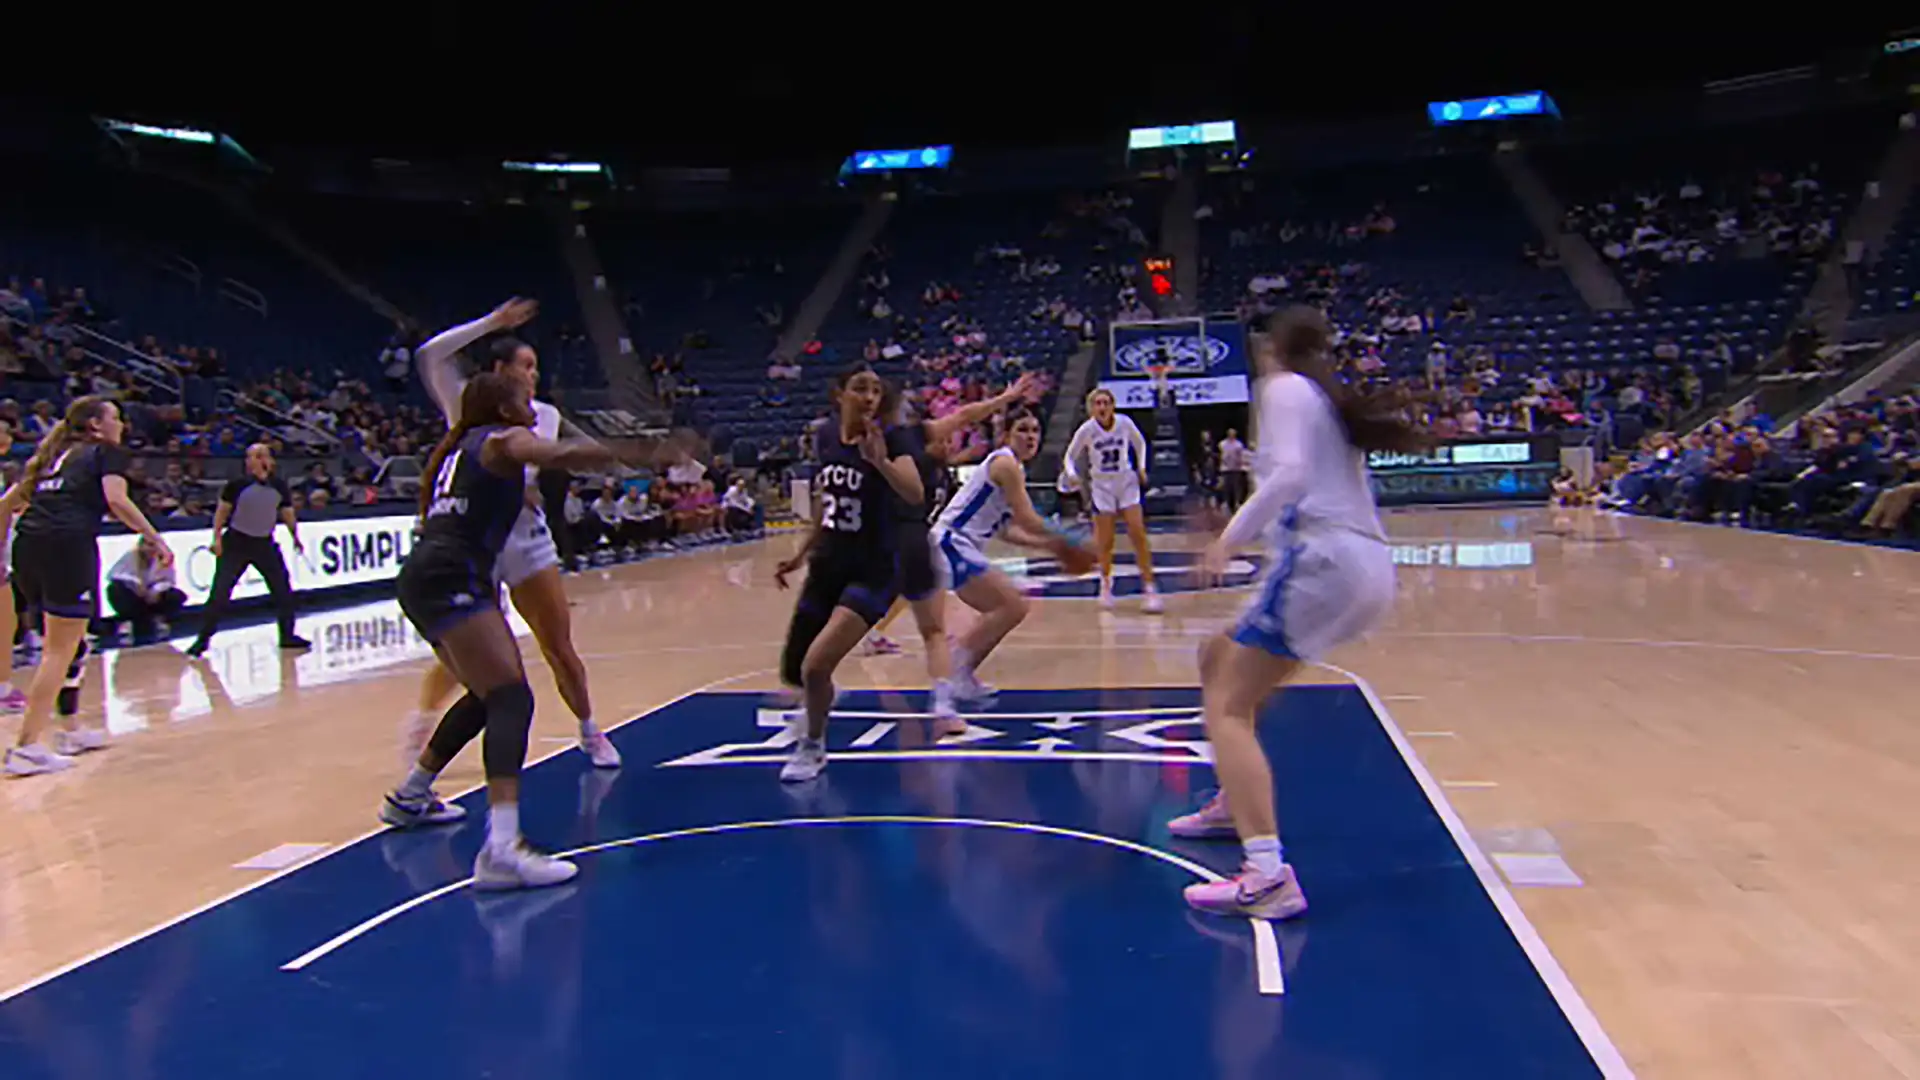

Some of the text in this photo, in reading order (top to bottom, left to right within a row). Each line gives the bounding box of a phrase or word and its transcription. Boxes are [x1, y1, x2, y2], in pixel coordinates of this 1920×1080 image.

[821, 464, 864, 491] TCU
[821, 493, 862, 532] 23
[321, 529, 405, 573] SIMPL
